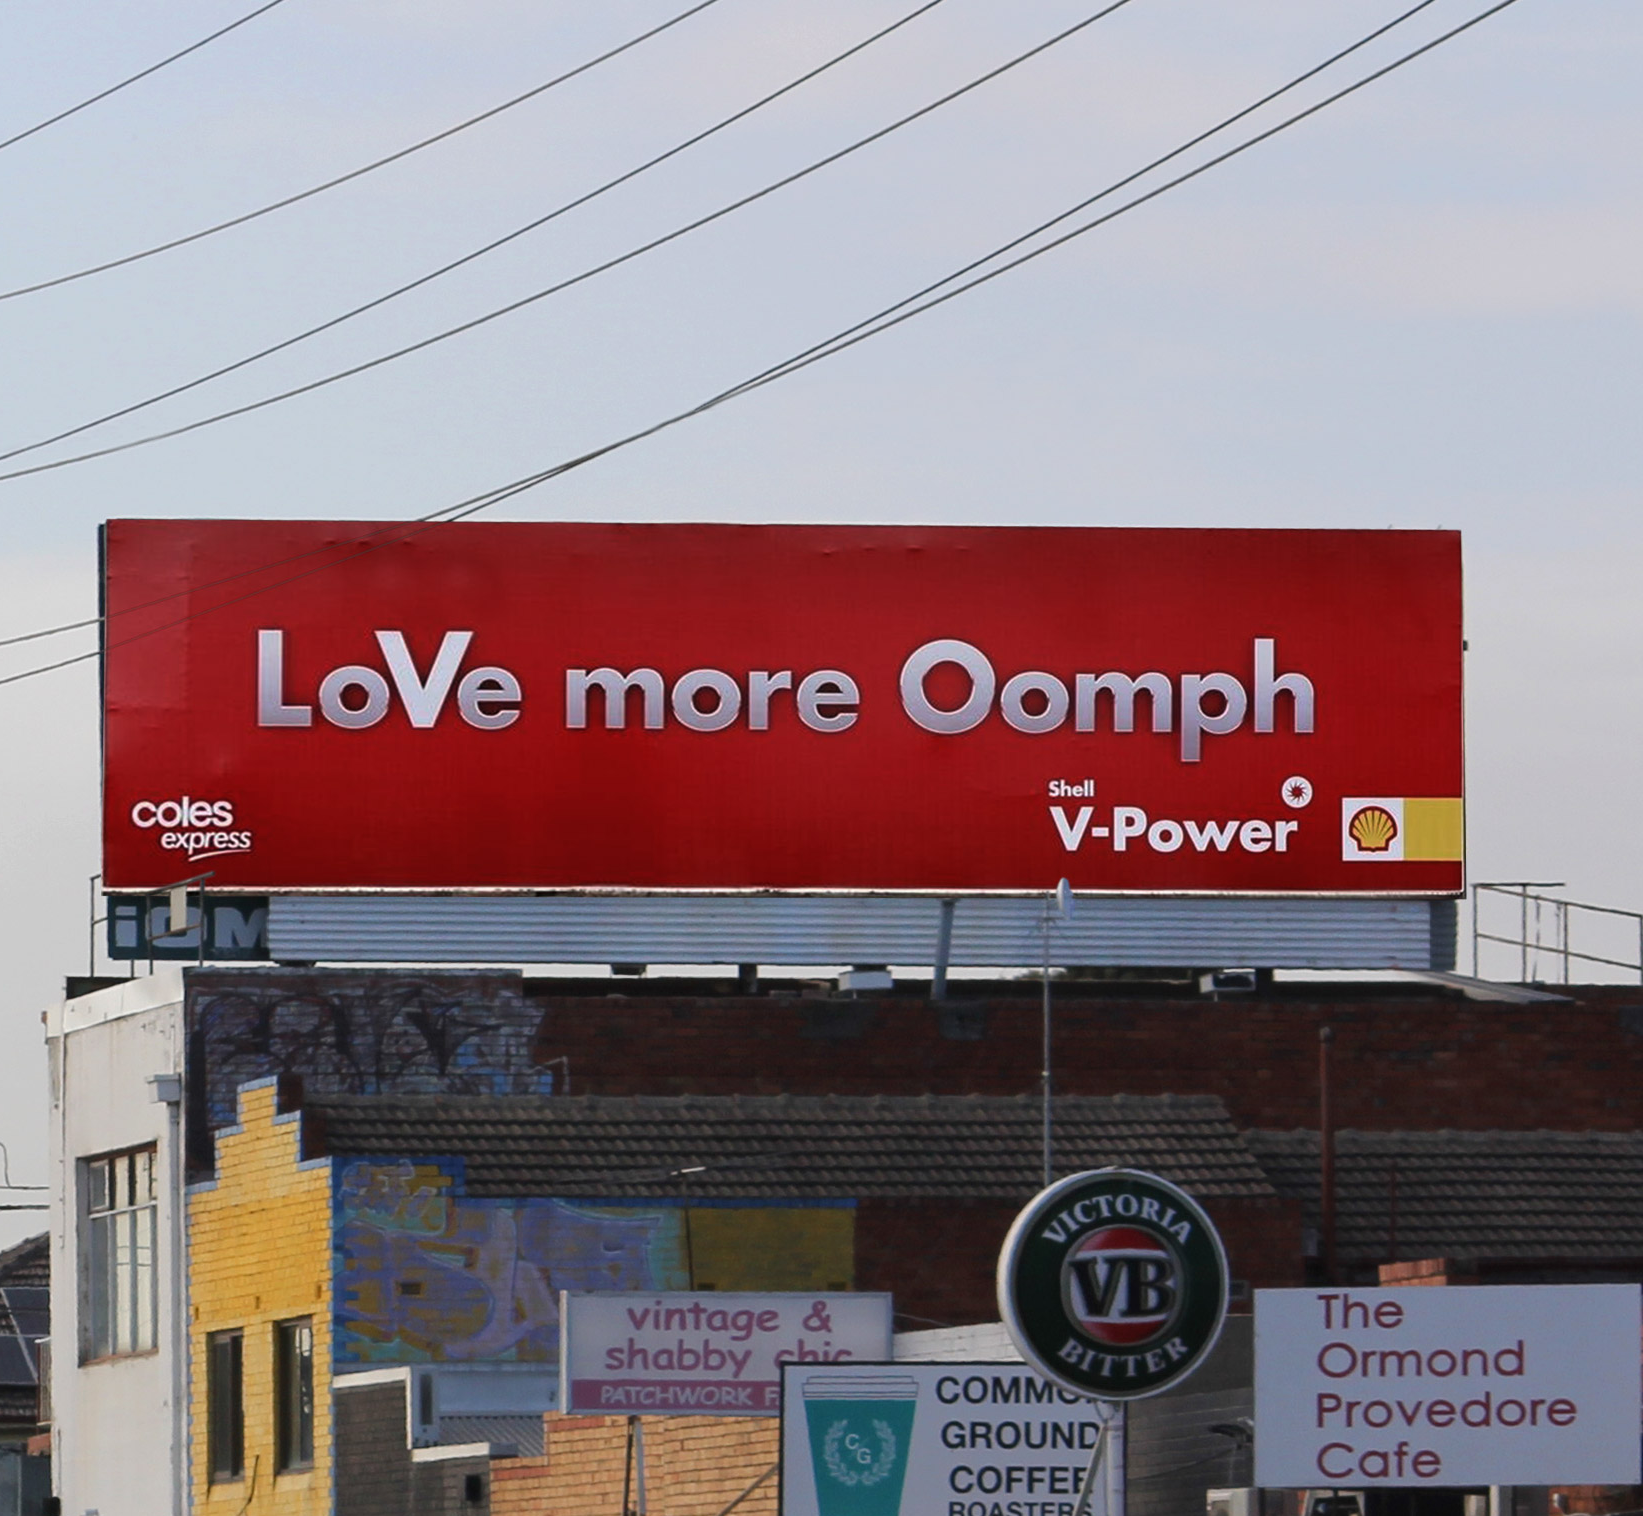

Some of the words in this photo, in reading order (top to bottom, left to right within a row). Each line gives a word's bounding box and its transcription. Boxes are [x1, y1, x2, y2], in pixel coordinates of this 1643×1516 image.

[258, 629, 522, 731] LoVe
[565, 667, 860, 733] more
[900, 638, 1314, 762] Oomph
[1048, 780, 1095, 797] Shell
[131, 796, 234, 828] coles
[1049, 806, 1298, 852] V-Power
[161, 831, 252, 855] express
[1041, 1194, 1192, 1246] VICTORIA
[1067, 1256, 1177, 1318] VB
[626, 1300, 780, 1341] vintage
[802, 1300, 833, 1333] &
[1317, 1293, 1404, 1329] The
[604, 1337, 753, 1379] shabby
[1058, 1336, 1189, 1377] BITTER
[1317, 1339, 1525, 1378] Ormond
[600, 1385, 755, 1406] PATCHWORK
[936, 1376, 1105, 1404] COMM
[1317, 1391, 1578, 1428] Provedore
[941, 1421, 1101, 1449] GROUND
[1317, 1441, 1442, 1478] Cafe
[949, 1465, 1094, 1494] COFFEE
